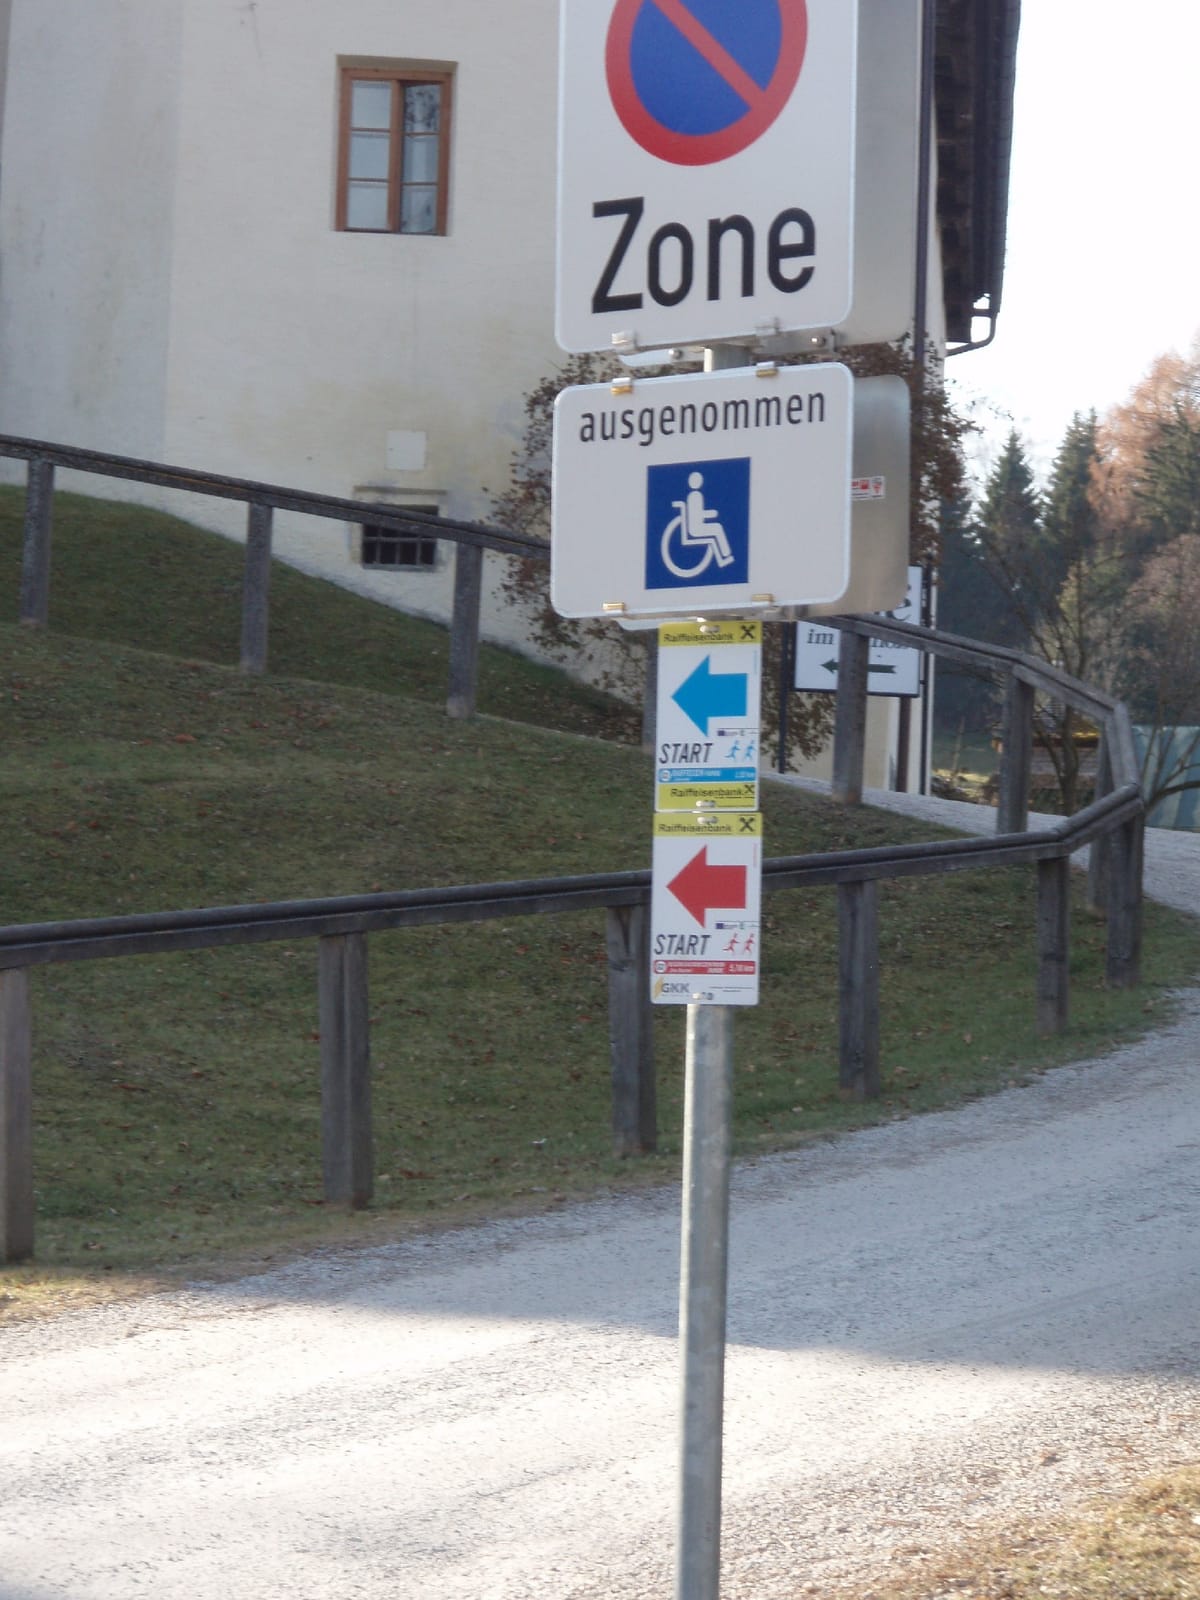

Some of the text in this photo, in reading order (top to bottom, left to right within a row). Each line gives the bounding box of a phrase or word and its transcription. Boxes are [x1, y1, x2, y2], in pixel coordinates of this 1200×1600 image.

[592, 196, 816, 314] Zone
[580, 392, 825, 446] ausgenommen
[663, 633, 734, 642] Raiffeisenbank
[806, 628, 834, 645] im
[659, 742, 714, 764] START
[658, 823, 732, 833] Raiffeisenbank
[654, 933, 711, 955] START
[661, 982, 690, 993] GKK
